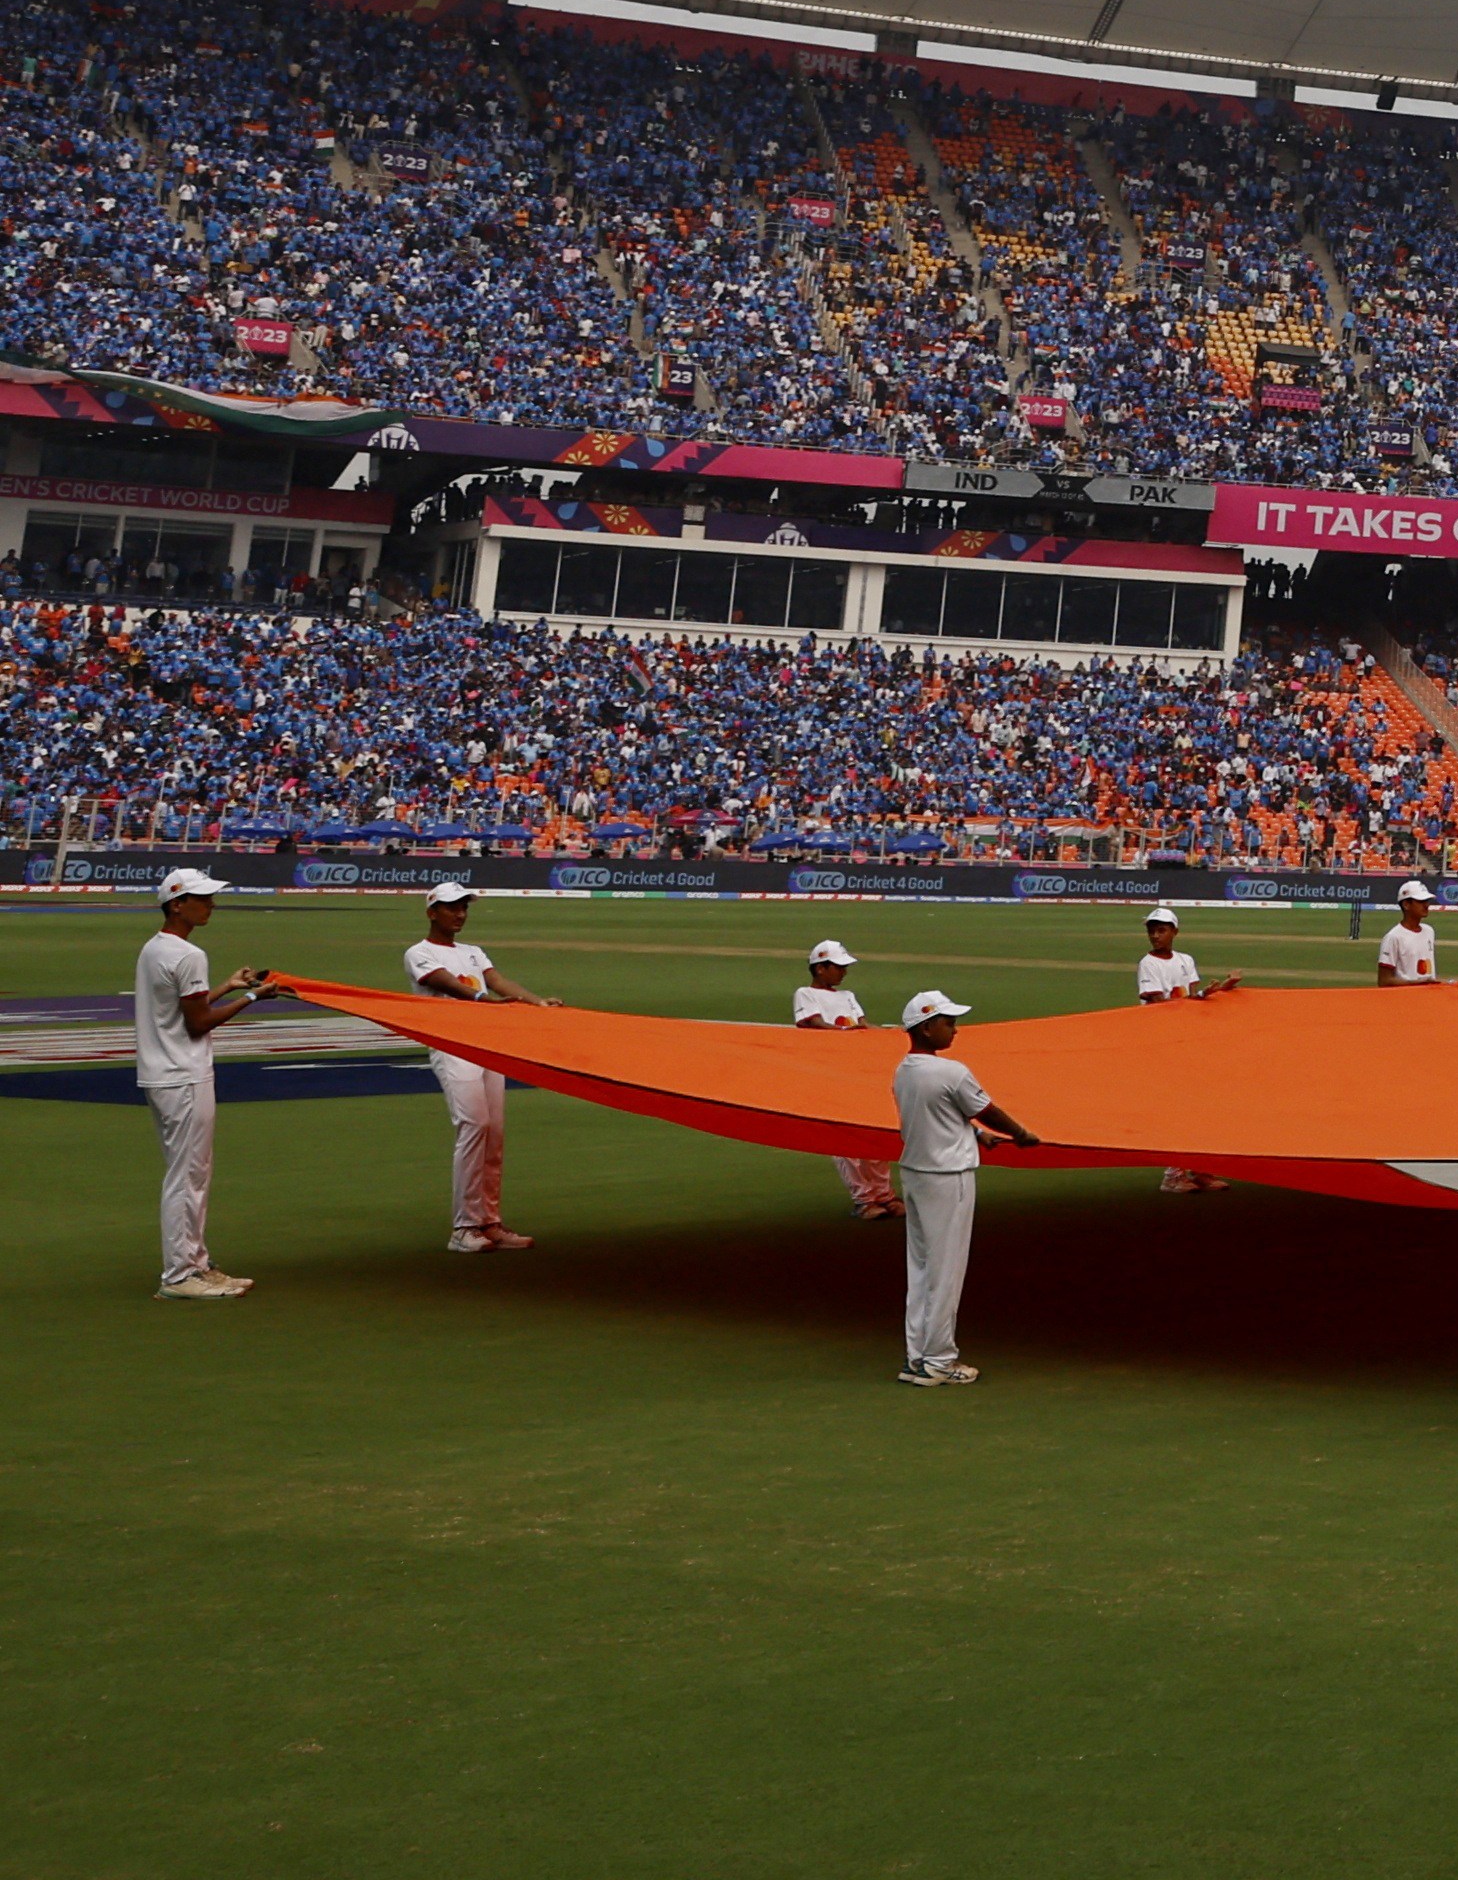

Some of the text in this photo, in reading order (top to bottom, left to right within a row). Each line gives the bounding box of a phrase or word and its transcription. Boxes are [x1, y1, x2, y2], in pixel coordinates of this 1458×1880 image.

[954, 472, 998, 490] IND
[1056, 479, 1070, 489] VS
[55, 482, 155, 504] CRICKET
[160, 489, 241, 511] WORLD
[246, 496, 290, 514] CUP
[1129, 485, 1176, 504] PAK
[1257, 501, 1296, 532] IT
[1306, 505, 1442, 541] TAKES
[94, 864, 153, 880] Cricket
[155, 866, 166, 880] 4
[324, 866, 356, 882] ICC
[361, 868, 417, 882] Cricket
[418, 869, 430, 882] 4
[578, 870, 715, 886] ICC Cricket 4 Good
[815, 875, 943, 890] ICC Cricket 4 Good
[1037, 878, 1159, 894] ICC Cricket 4 Good
[1250, 883, 1370, 899] ICC Cricket 4 Good
